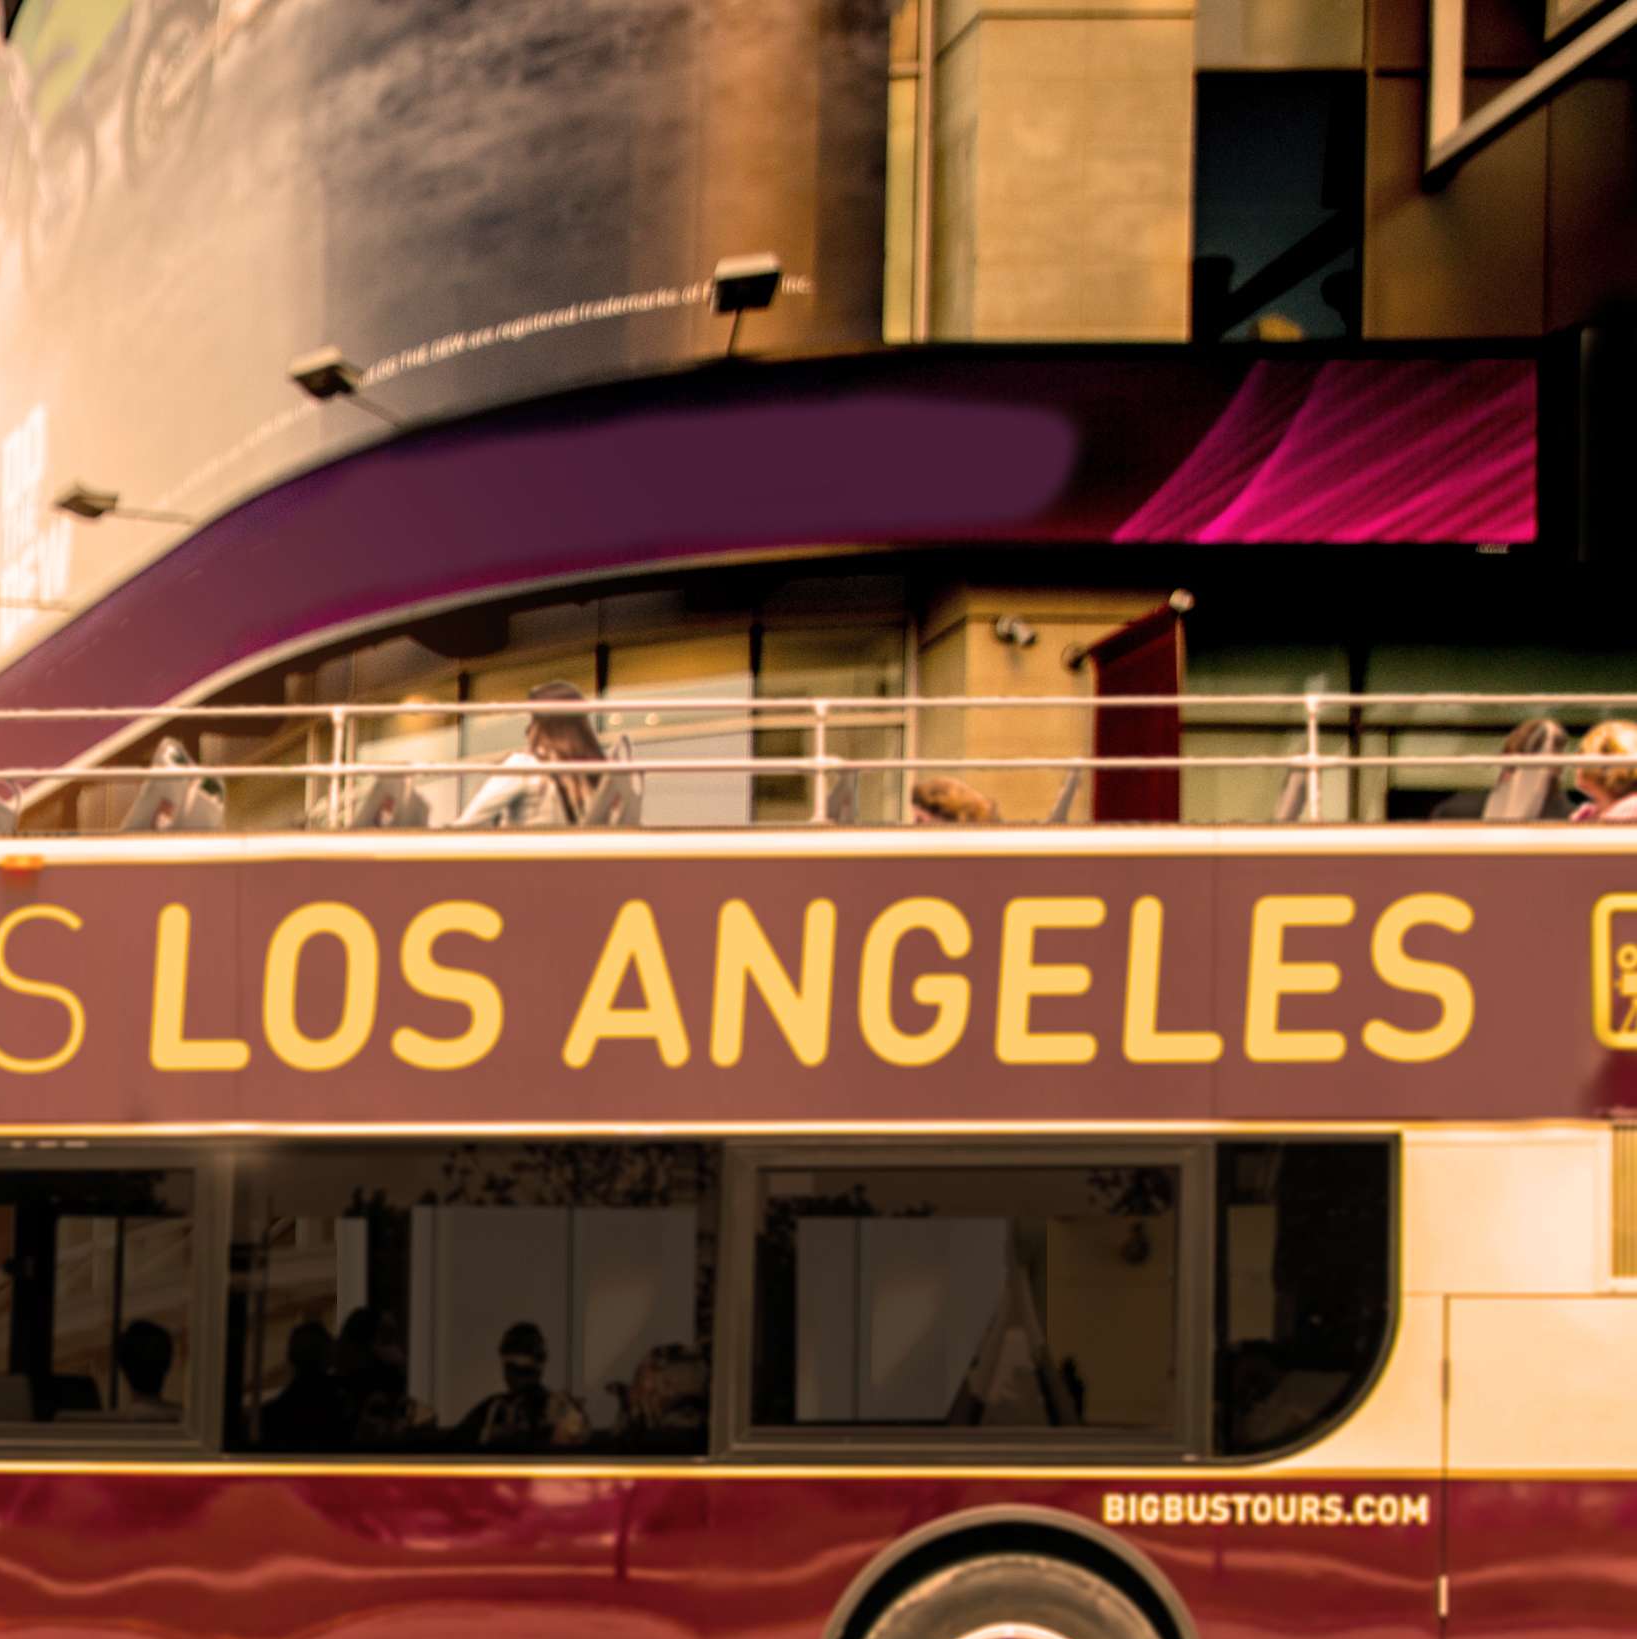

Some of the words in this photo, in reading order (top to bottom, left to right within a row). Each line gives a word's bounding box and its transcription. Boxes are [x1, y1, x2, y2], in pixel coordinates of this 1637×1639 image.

[400, 341, 429, 370] THE
[467, 327, 496, 350] are
[495, 303, 578, 341] registered
[578, 286, 680, 322] trademarks
[149, 900, 504, 1074] LOS
[562, 892, 1475, 1068] ANGELES
[1102, 1493, 1430, 1526] BIGBUSTOURS.COM
